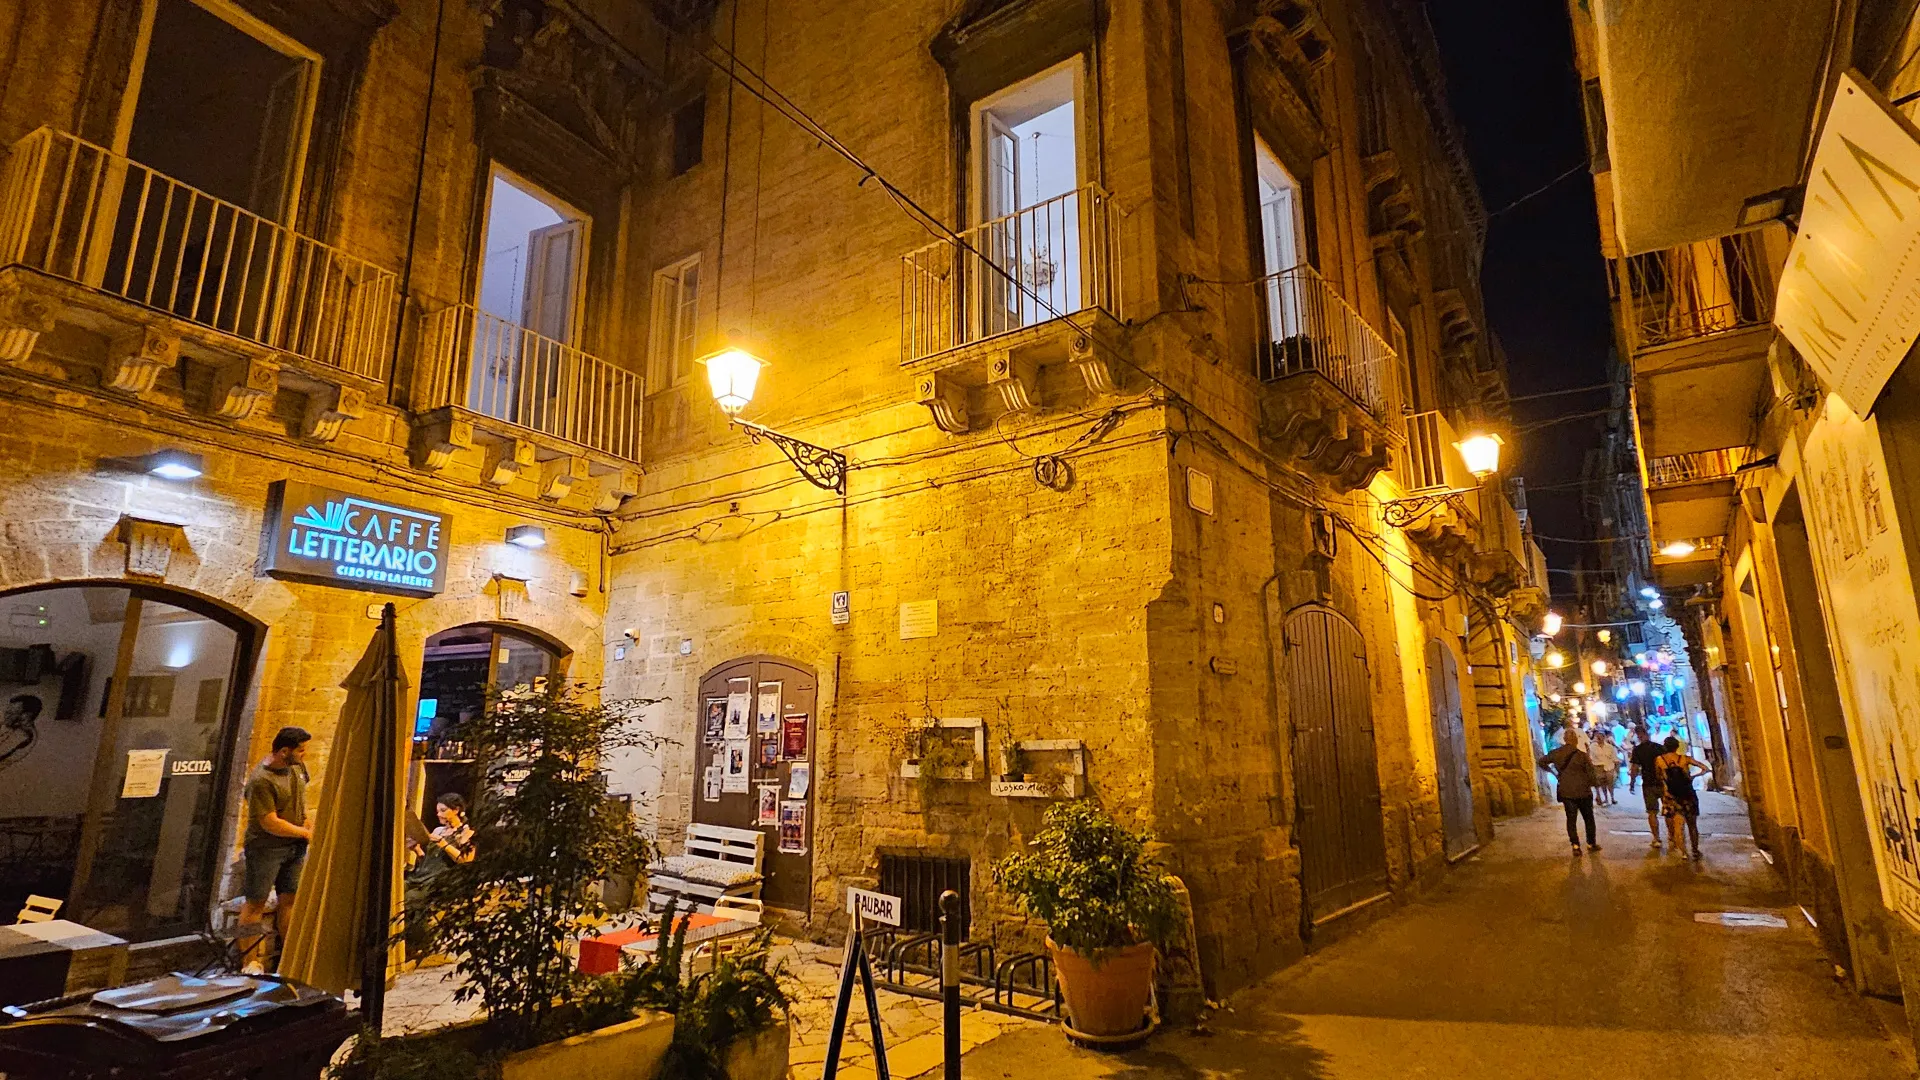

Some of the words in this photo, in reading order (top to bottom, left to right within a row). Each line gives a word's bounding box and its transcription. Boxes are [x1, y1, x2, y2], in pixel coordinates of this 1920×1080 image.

[289, 528, 437, 575] LETTERARIO
[336, 565, 365, 578] CIBO
[366, 569, 386, 581] PER
[387, 571, 400, 583] LA
[400, 575, 433, 588] MENTE
[172, 760, 212, 773] USCITA
